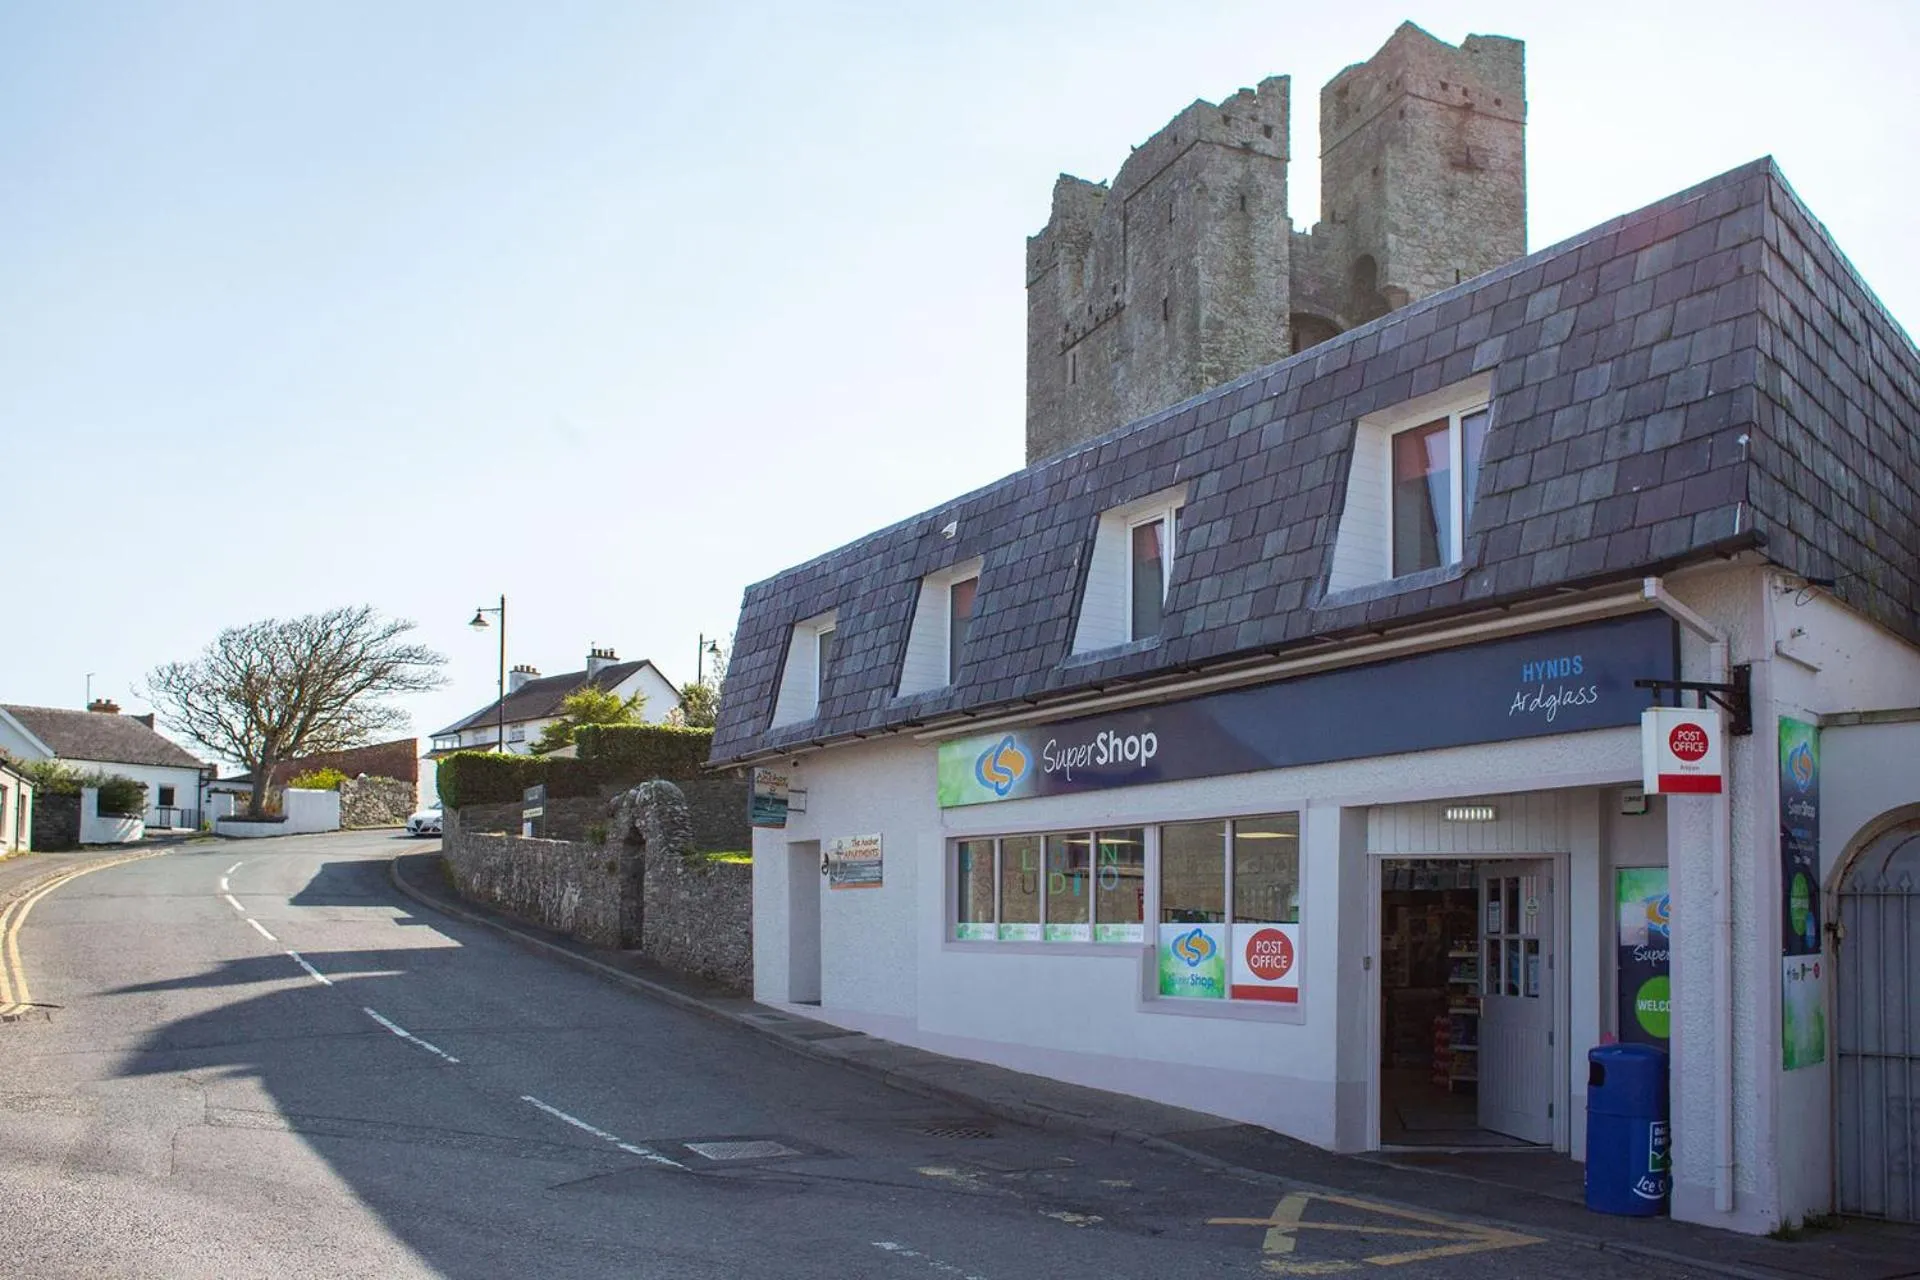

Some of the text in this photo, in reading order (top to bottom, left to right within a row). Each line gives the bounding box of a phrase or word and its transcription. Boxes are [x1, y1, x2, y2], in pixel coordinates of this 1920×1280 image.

[1522, 655, 1584, 683] HYNDS
[1508, 684, 1599, 723] Ardglass
[1677, 730, 1701, 741] POST
[1672, 741, 1705, 753] OFFICE
[1042, 729, 1158, 782] SuperShop
[1255, 940, 1283, 955] POST
[1250, 955, 1288, 970] OFFICE
[1637, 1175, 1656, 1193] Ice
